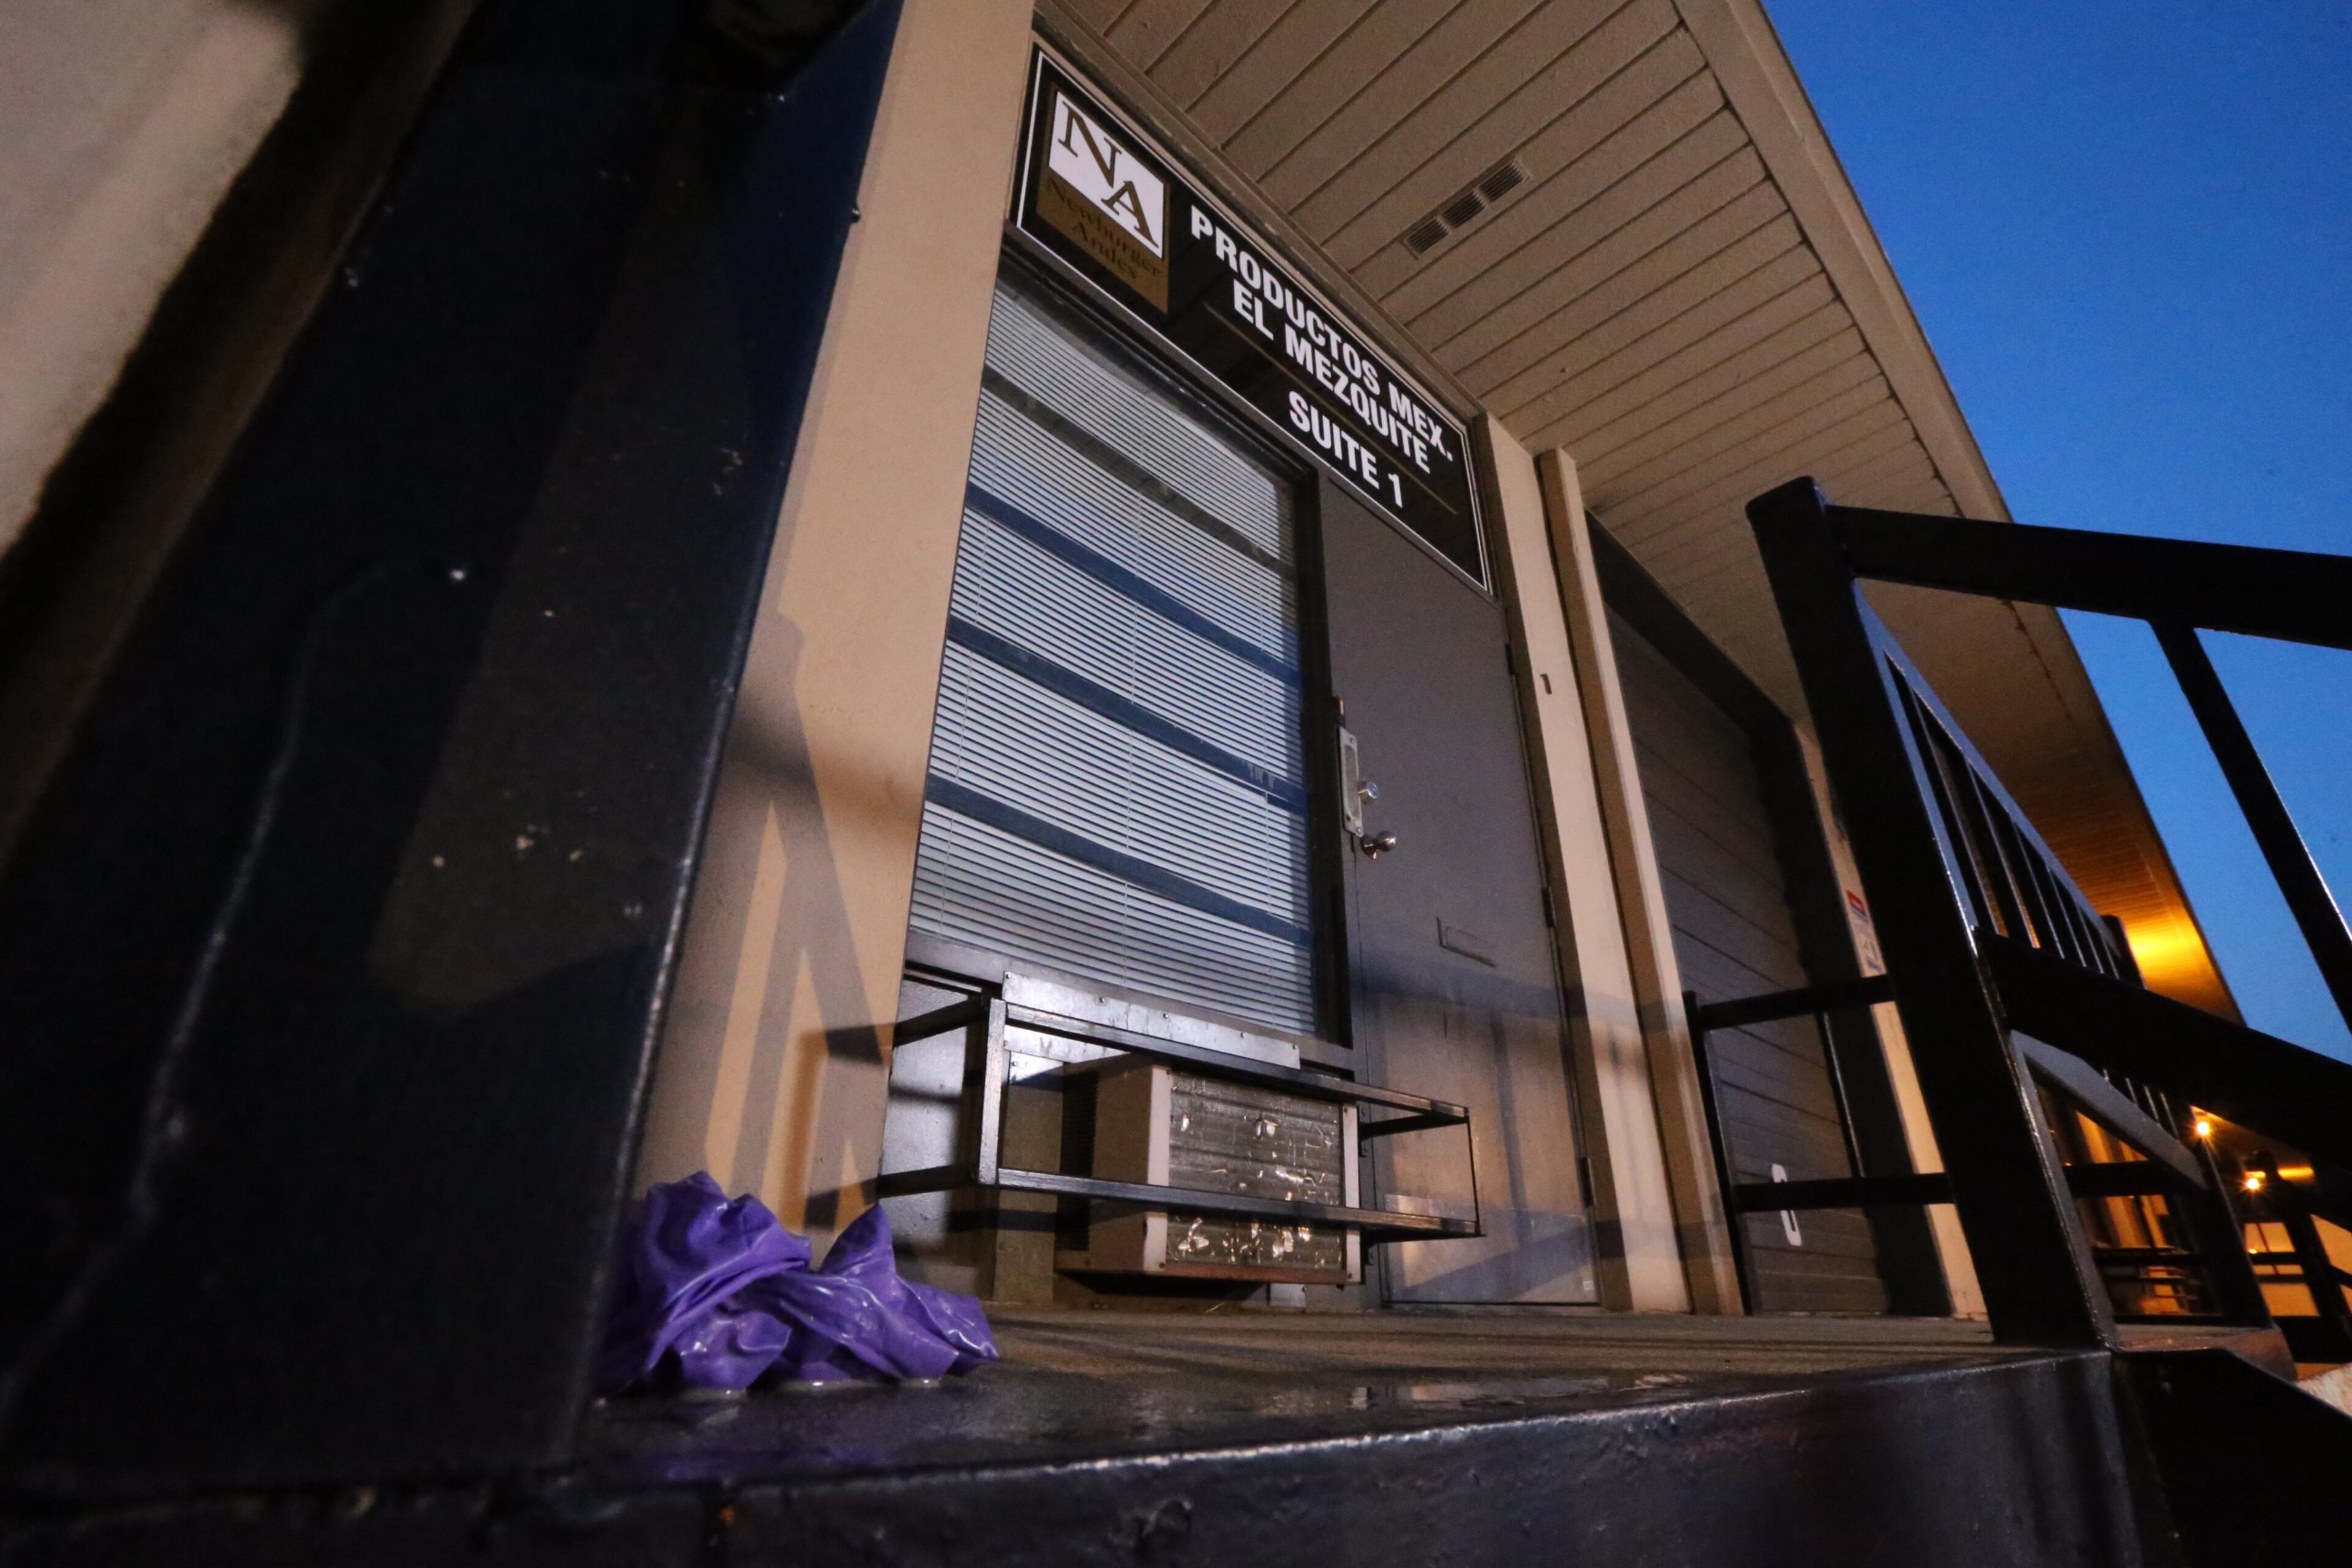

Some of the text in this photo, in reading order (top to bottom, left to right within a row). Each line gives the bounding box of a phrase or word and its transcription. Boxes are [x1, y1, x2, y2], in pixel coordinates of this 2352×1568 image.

[1071, 221, 1137, 279] Andes
[1191, 205, 1453, 461] PRODUCTOS MEX.
[1234, 279, 1430, 474] EL MEZQUITE
[1289, 391, 1403, 508] SUITE 1
